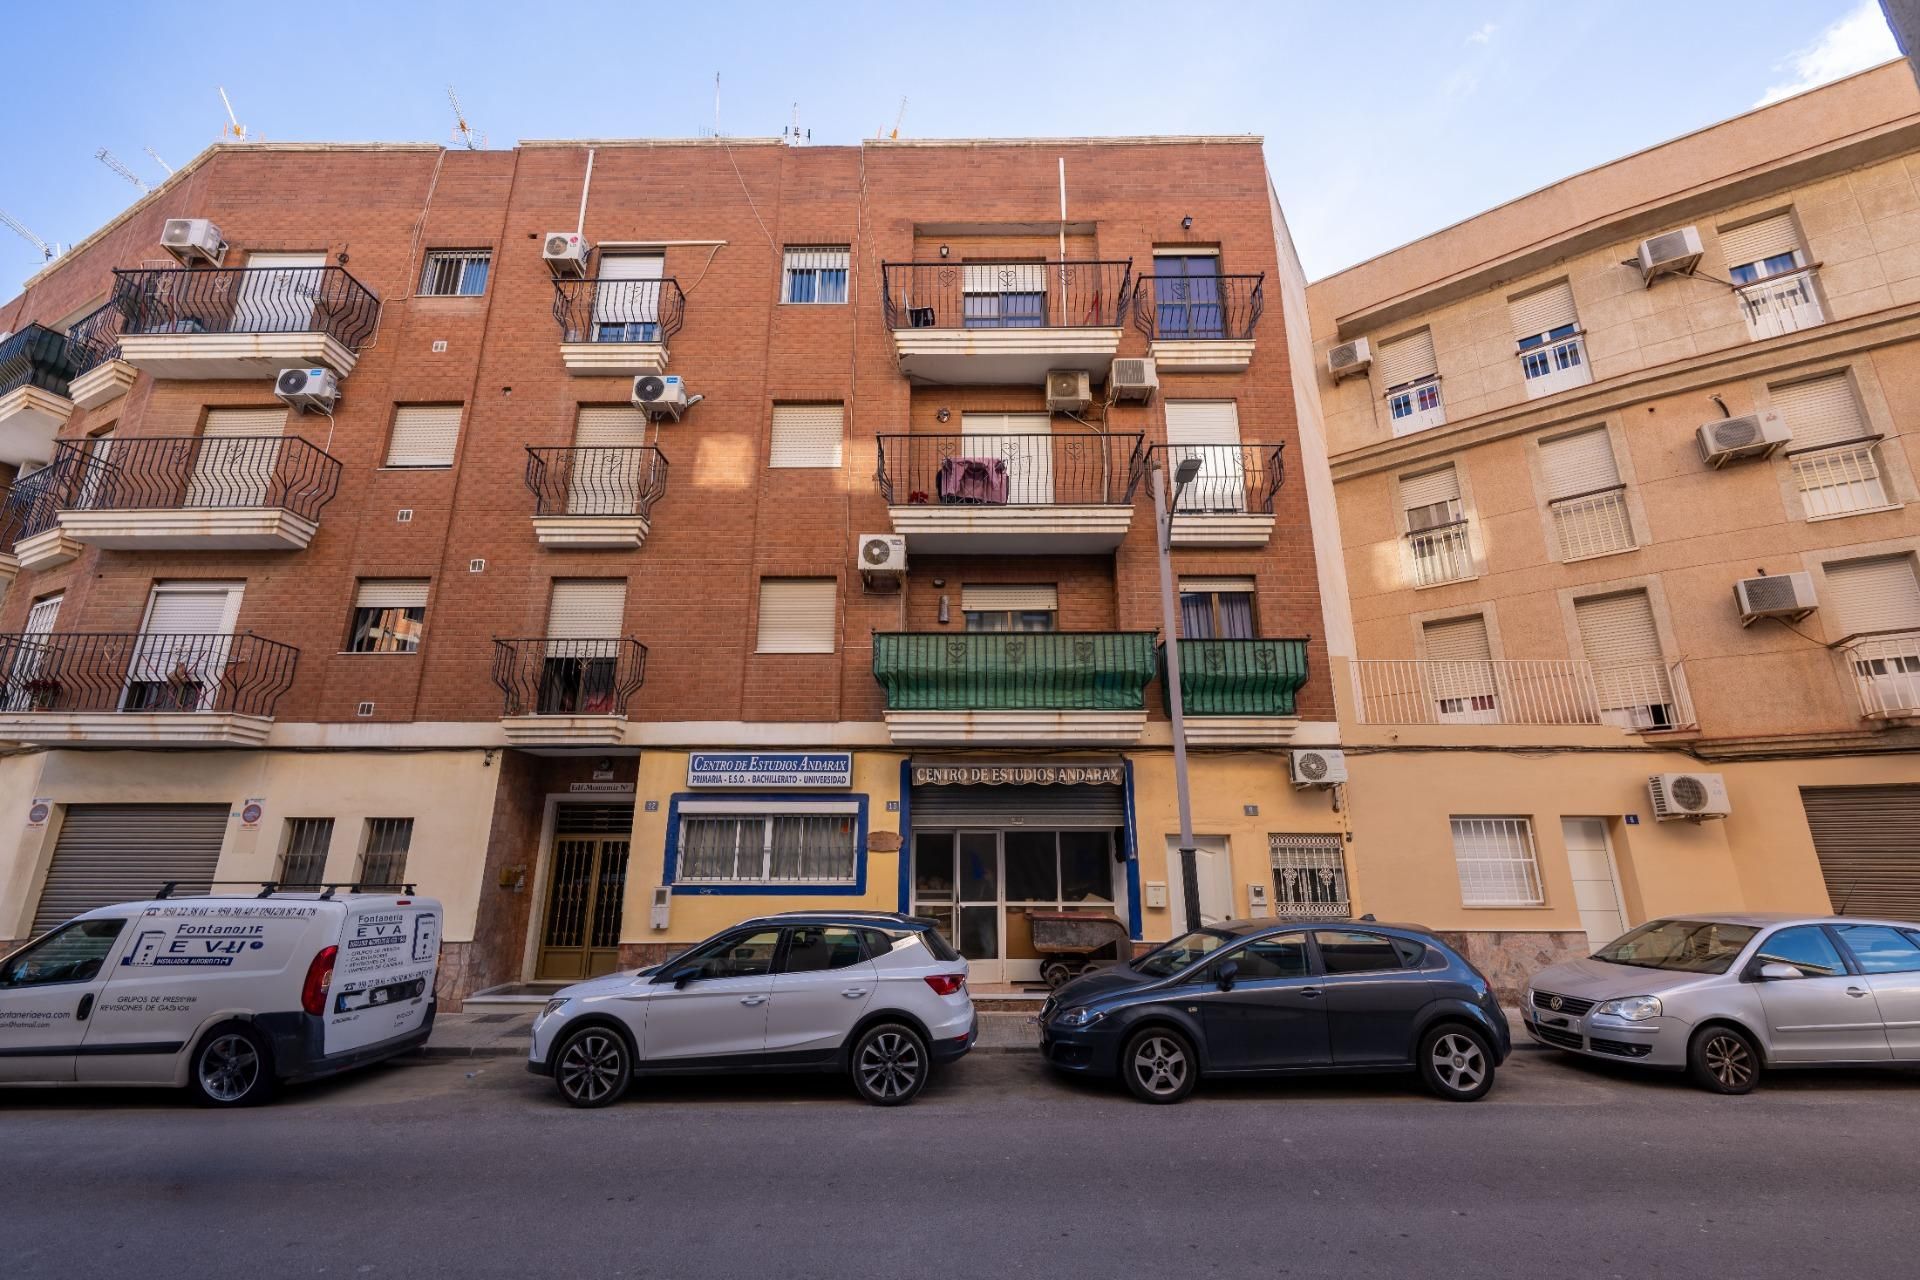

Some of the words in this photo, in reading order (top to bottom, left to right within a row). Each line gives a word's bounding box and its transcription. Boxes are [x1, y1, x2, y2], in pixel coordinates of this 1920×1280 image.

[694, 756, 735, 771] CENTRO
[734, 760, 748, 771] DE
[748, 756, 798, 771] ESTUDIOS
[799, 756, 848, 771] ANDARAX
[916, 768, 967, 781] CENTRO
[971, 768, 989, 781] DE
[992, 768, 1055, 781] ESTUDIOS
[1058, 768, 1119, 781] ANDARAX
[692, 775, 723, 784] PRIMARIA
[728, 775, 746, 784] E.S.O.
[752, 775, 798, 784] BACHILLERATO
[803, 775, 847, 784] UNIVERSIDAD
[117, 995, 148, 1003] GRUPOS
[150, 995, 161, 1003] DE
[100, 1004, 143, 1012] REVISIONES
[145, 1004, 156, 1012] DE
